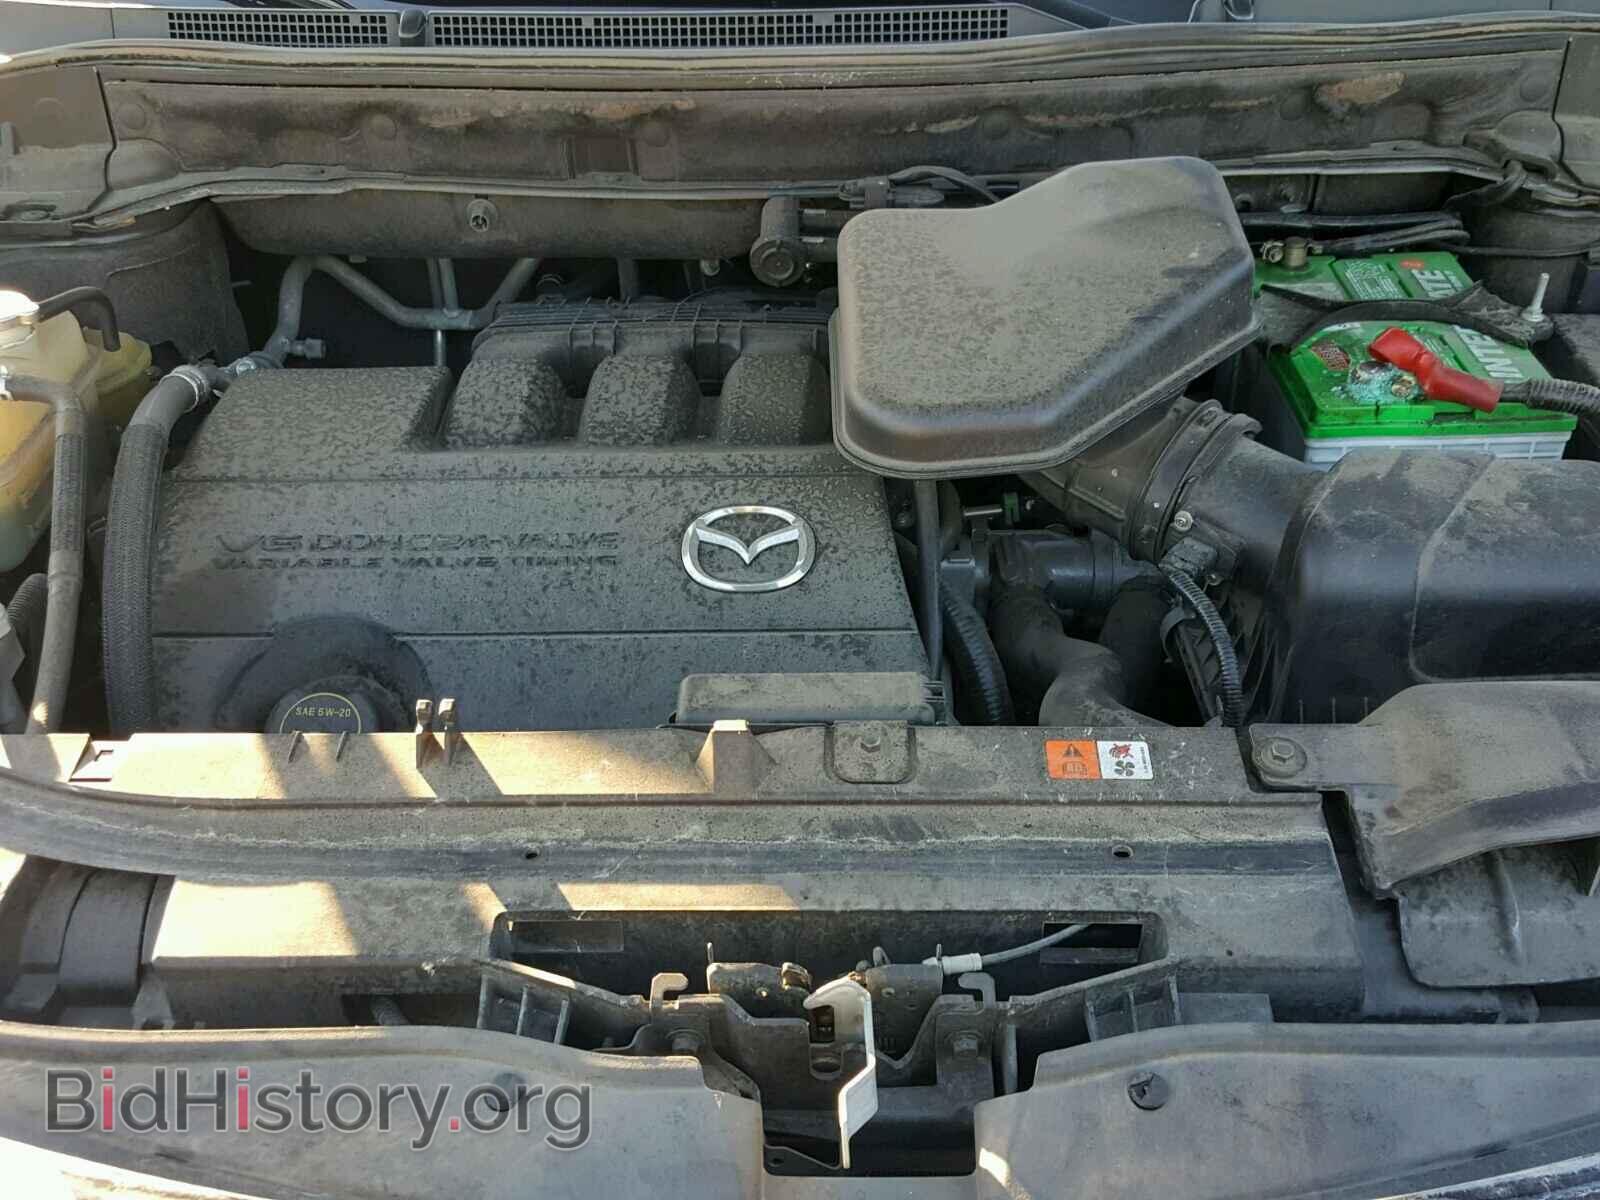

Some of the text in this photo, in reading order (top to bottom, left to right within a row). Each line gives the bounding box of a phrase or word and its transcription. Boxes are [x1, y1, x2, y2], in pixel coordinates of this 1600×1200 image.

[1411, 269, 1456, 298] ATE
[211, 557, 384, 570] VARIABLE
[390, 556, 499, 568] VALVE
[295, 707, 351, 718] SAE 5W-20
